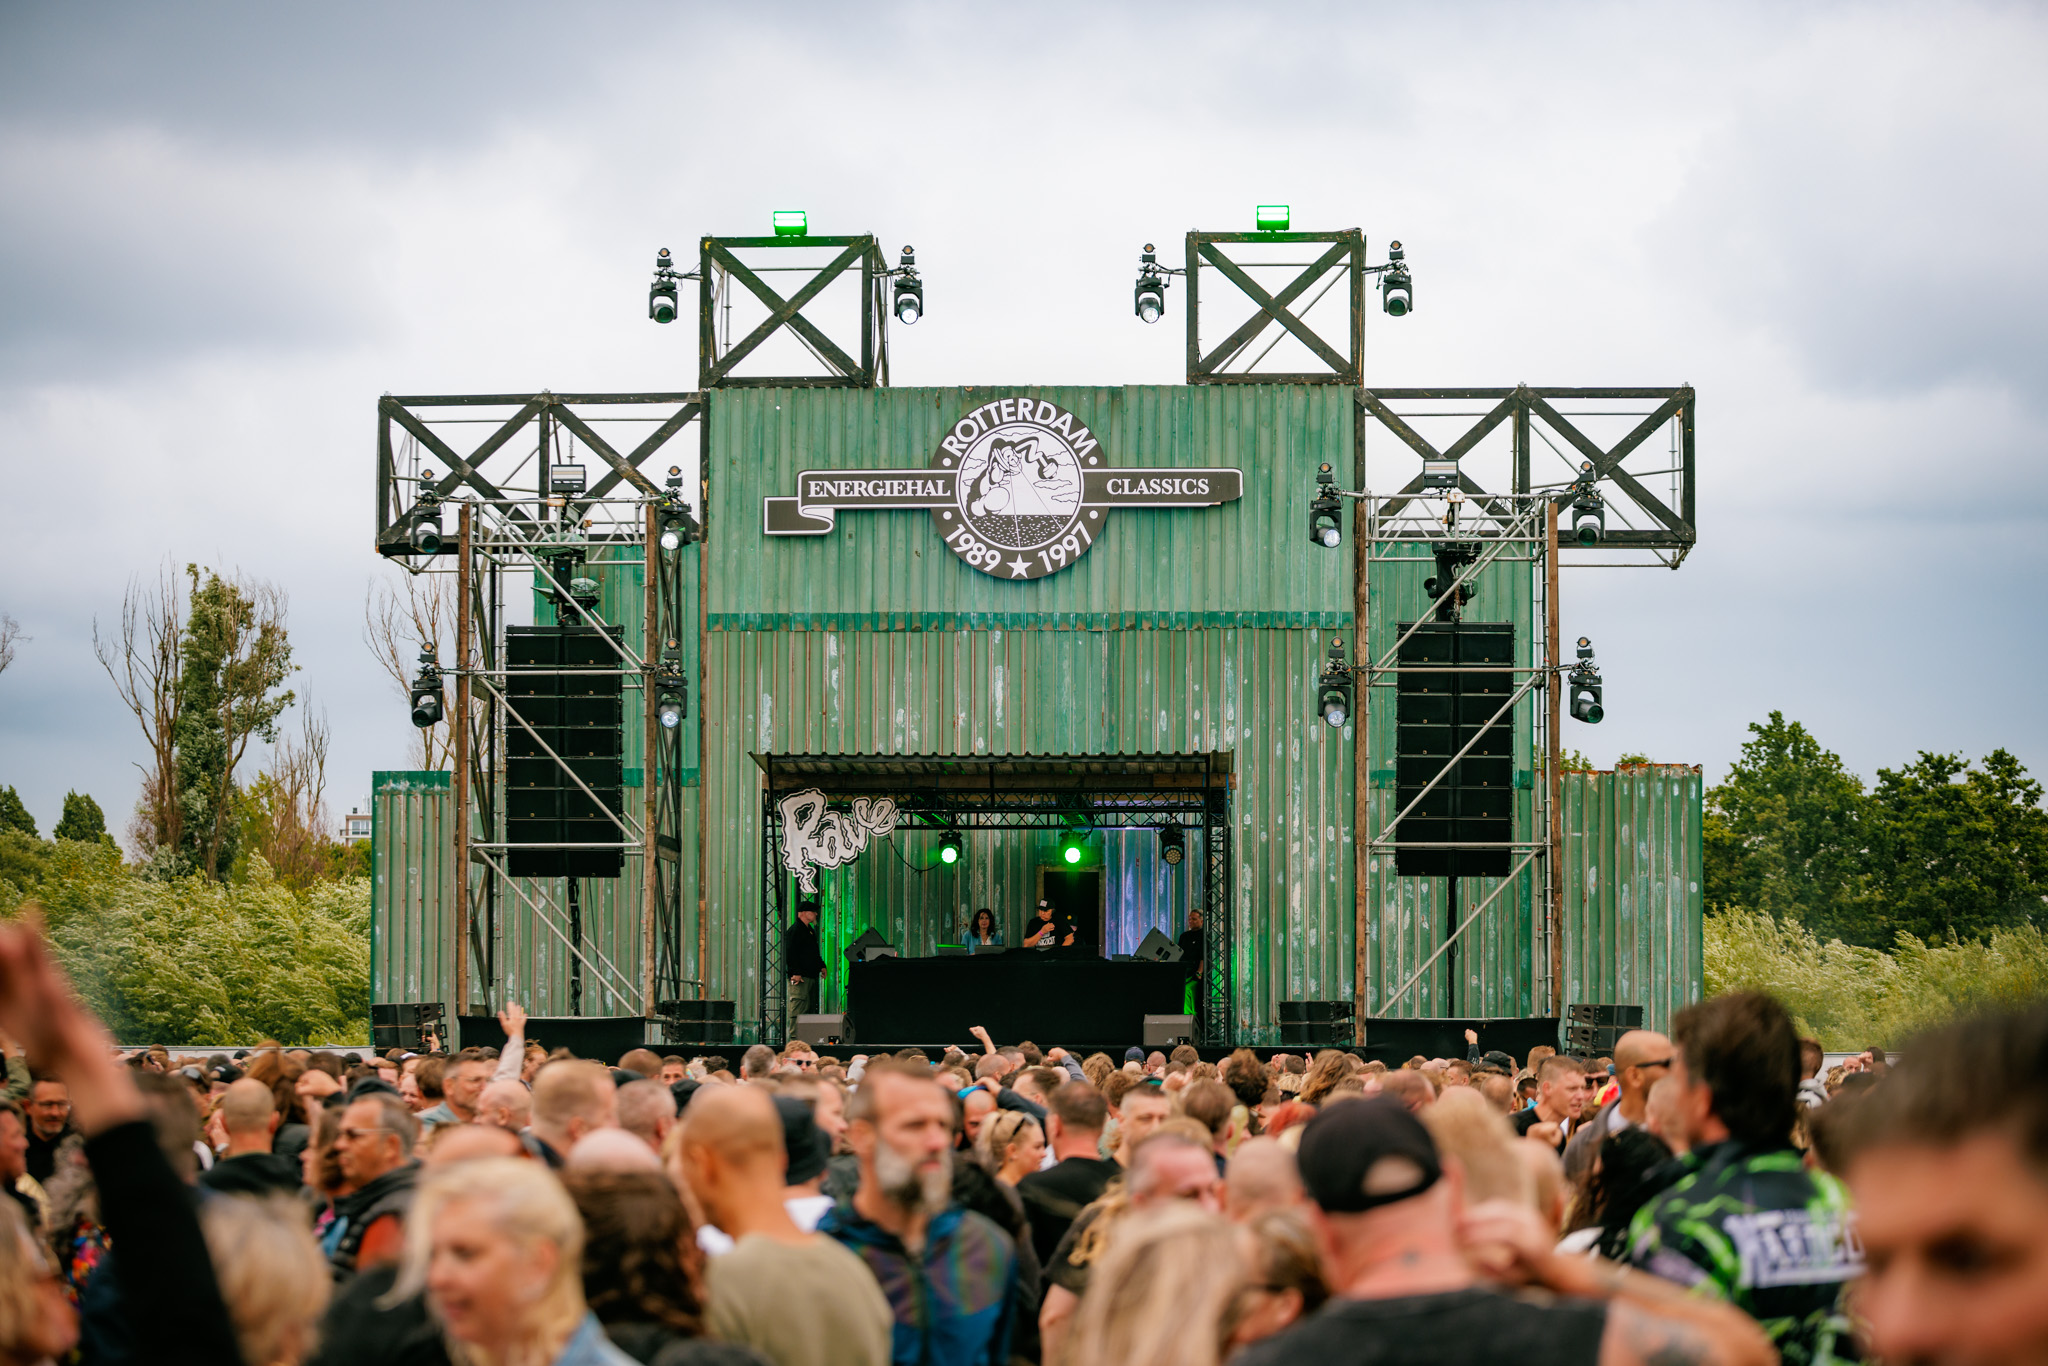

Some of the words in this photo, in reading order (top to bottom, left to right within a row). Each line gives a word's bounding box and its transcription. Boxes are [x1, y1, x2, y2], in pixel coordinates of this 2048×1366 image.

[941, 397, 1098, 458] ROTTERDAM
[808, 479, 951, 498] ENERGIEHAL
[1106, 477, 1210, 496] CLASSICS
[945, 523, 1002, 573] 1989
[1037, 520, 1093, 574] 1997
